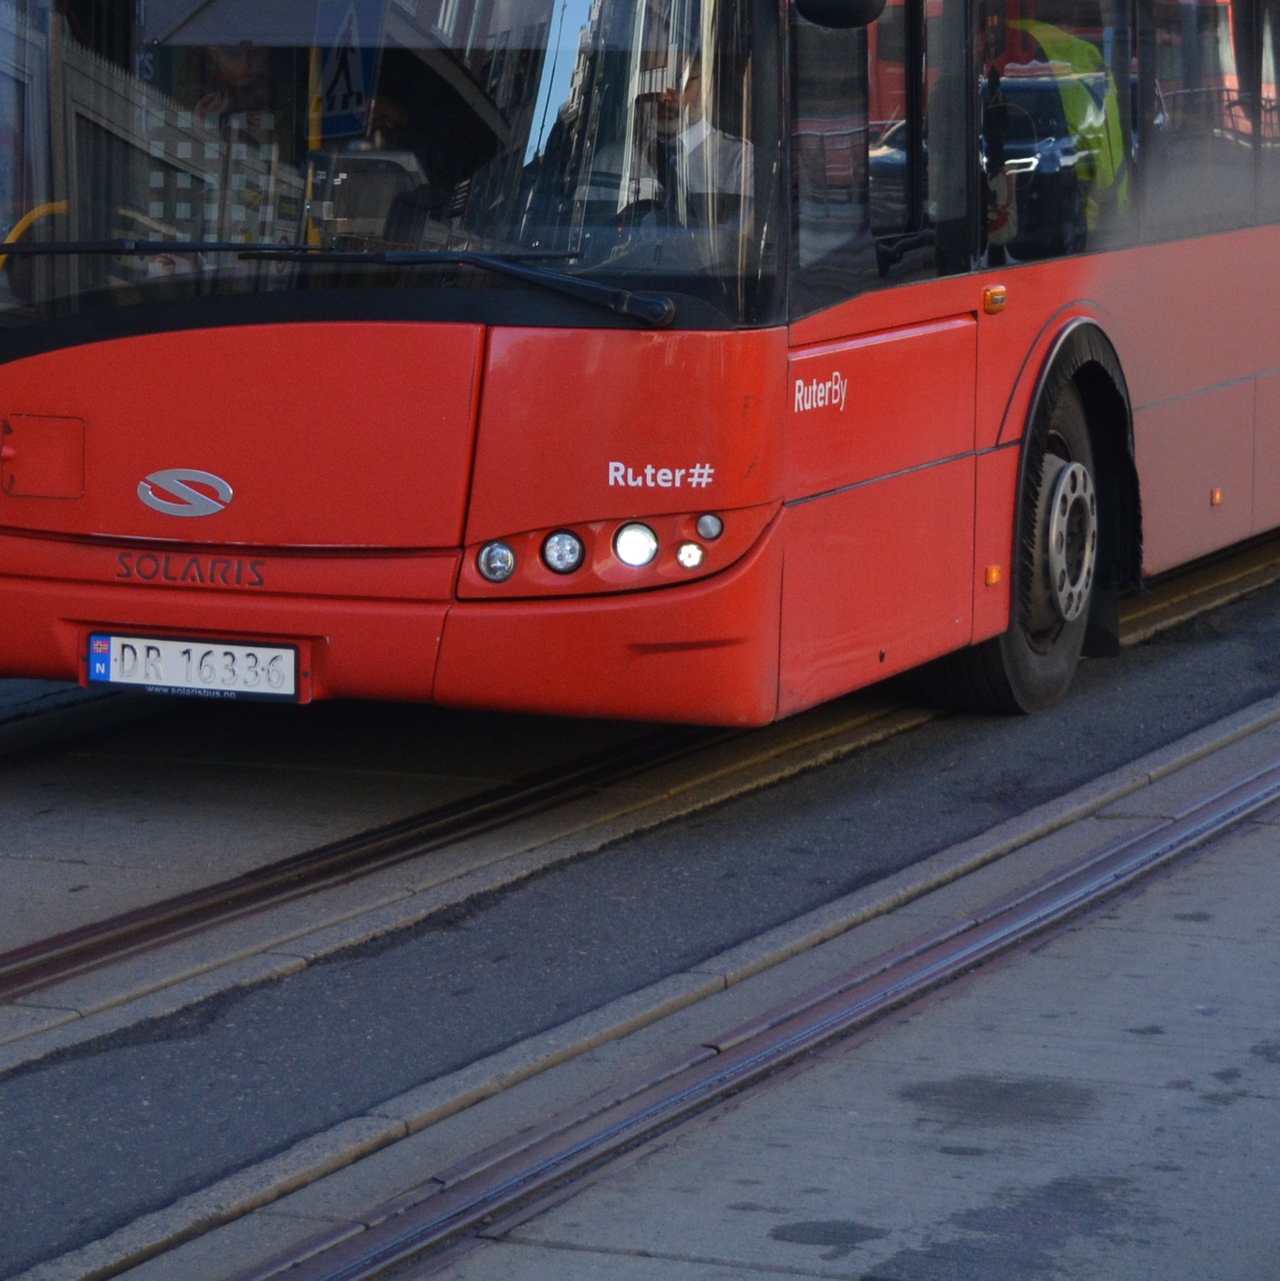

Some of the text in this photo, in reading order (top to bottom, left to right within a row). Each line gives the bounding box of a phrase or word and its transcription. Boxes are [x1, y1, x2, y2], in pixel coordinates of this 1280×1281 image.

[794, 371, 848, 413] RuterBy
[116, 551, 266, 587] SOLARIS
[95, 662, 106, 674] N
[120, 643, 163, 681] DR
